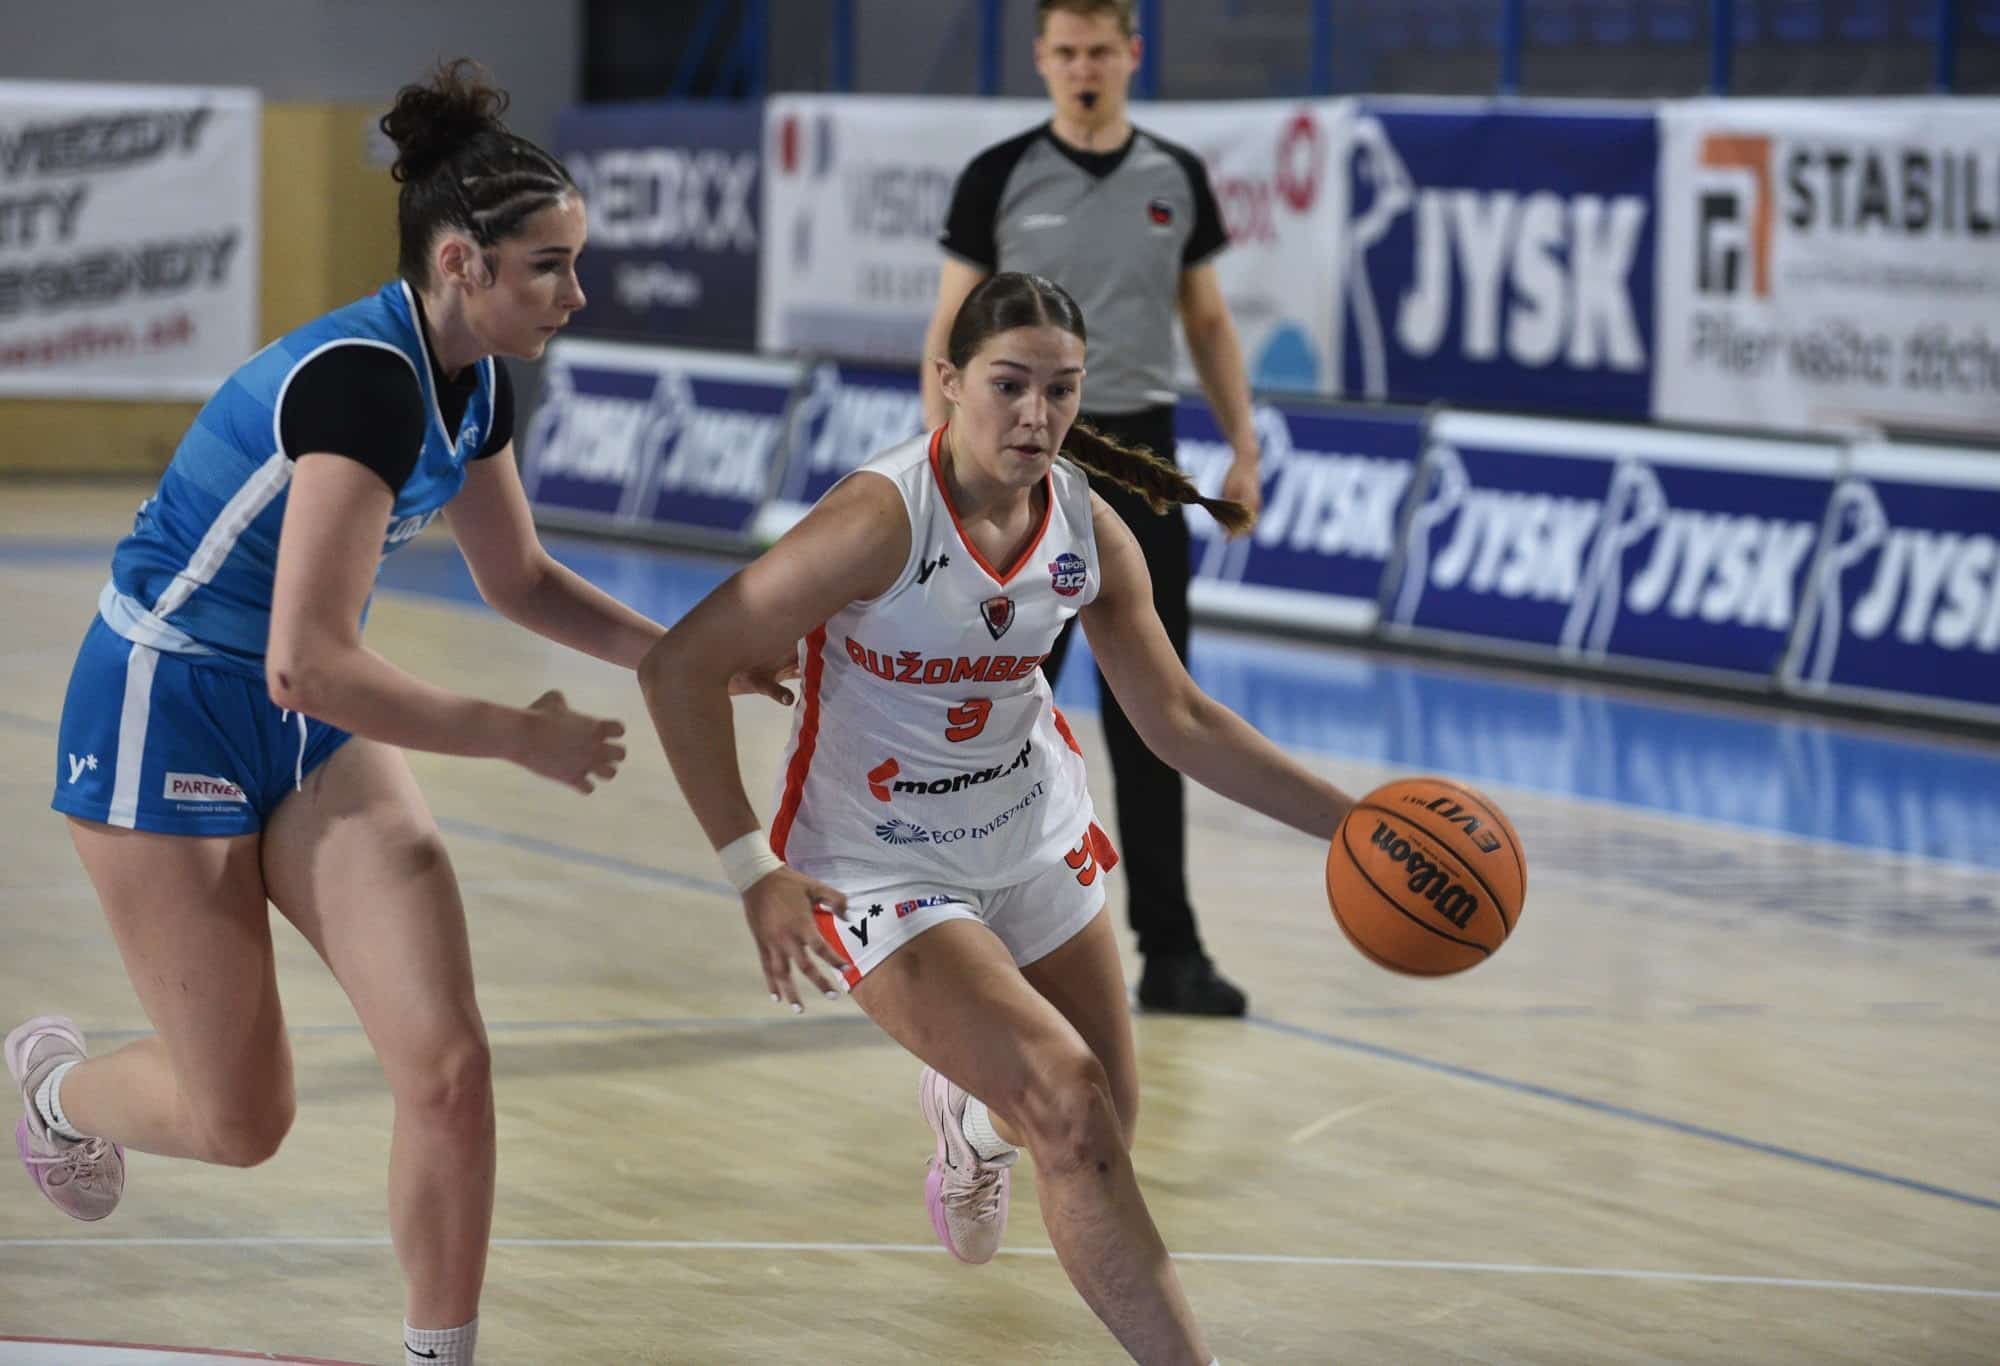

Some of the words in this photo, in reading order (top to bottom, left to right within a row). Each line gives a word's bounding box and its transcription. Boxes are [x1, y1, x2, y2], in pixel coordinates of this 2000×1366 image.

[1397, 188, 1646, 372] JYSK
[1255, 449, 1413, 559] JYSK
[1431, 488, 1599, 604] JYSK
[1626, 508, 1815, 632] JYSK
[1850, 527, 2000, 654] JYS
[944, 698, 993, 743] 9
[931, 828, 966, 844] ECO
[1370, 820, 1479, 930] Wilson
